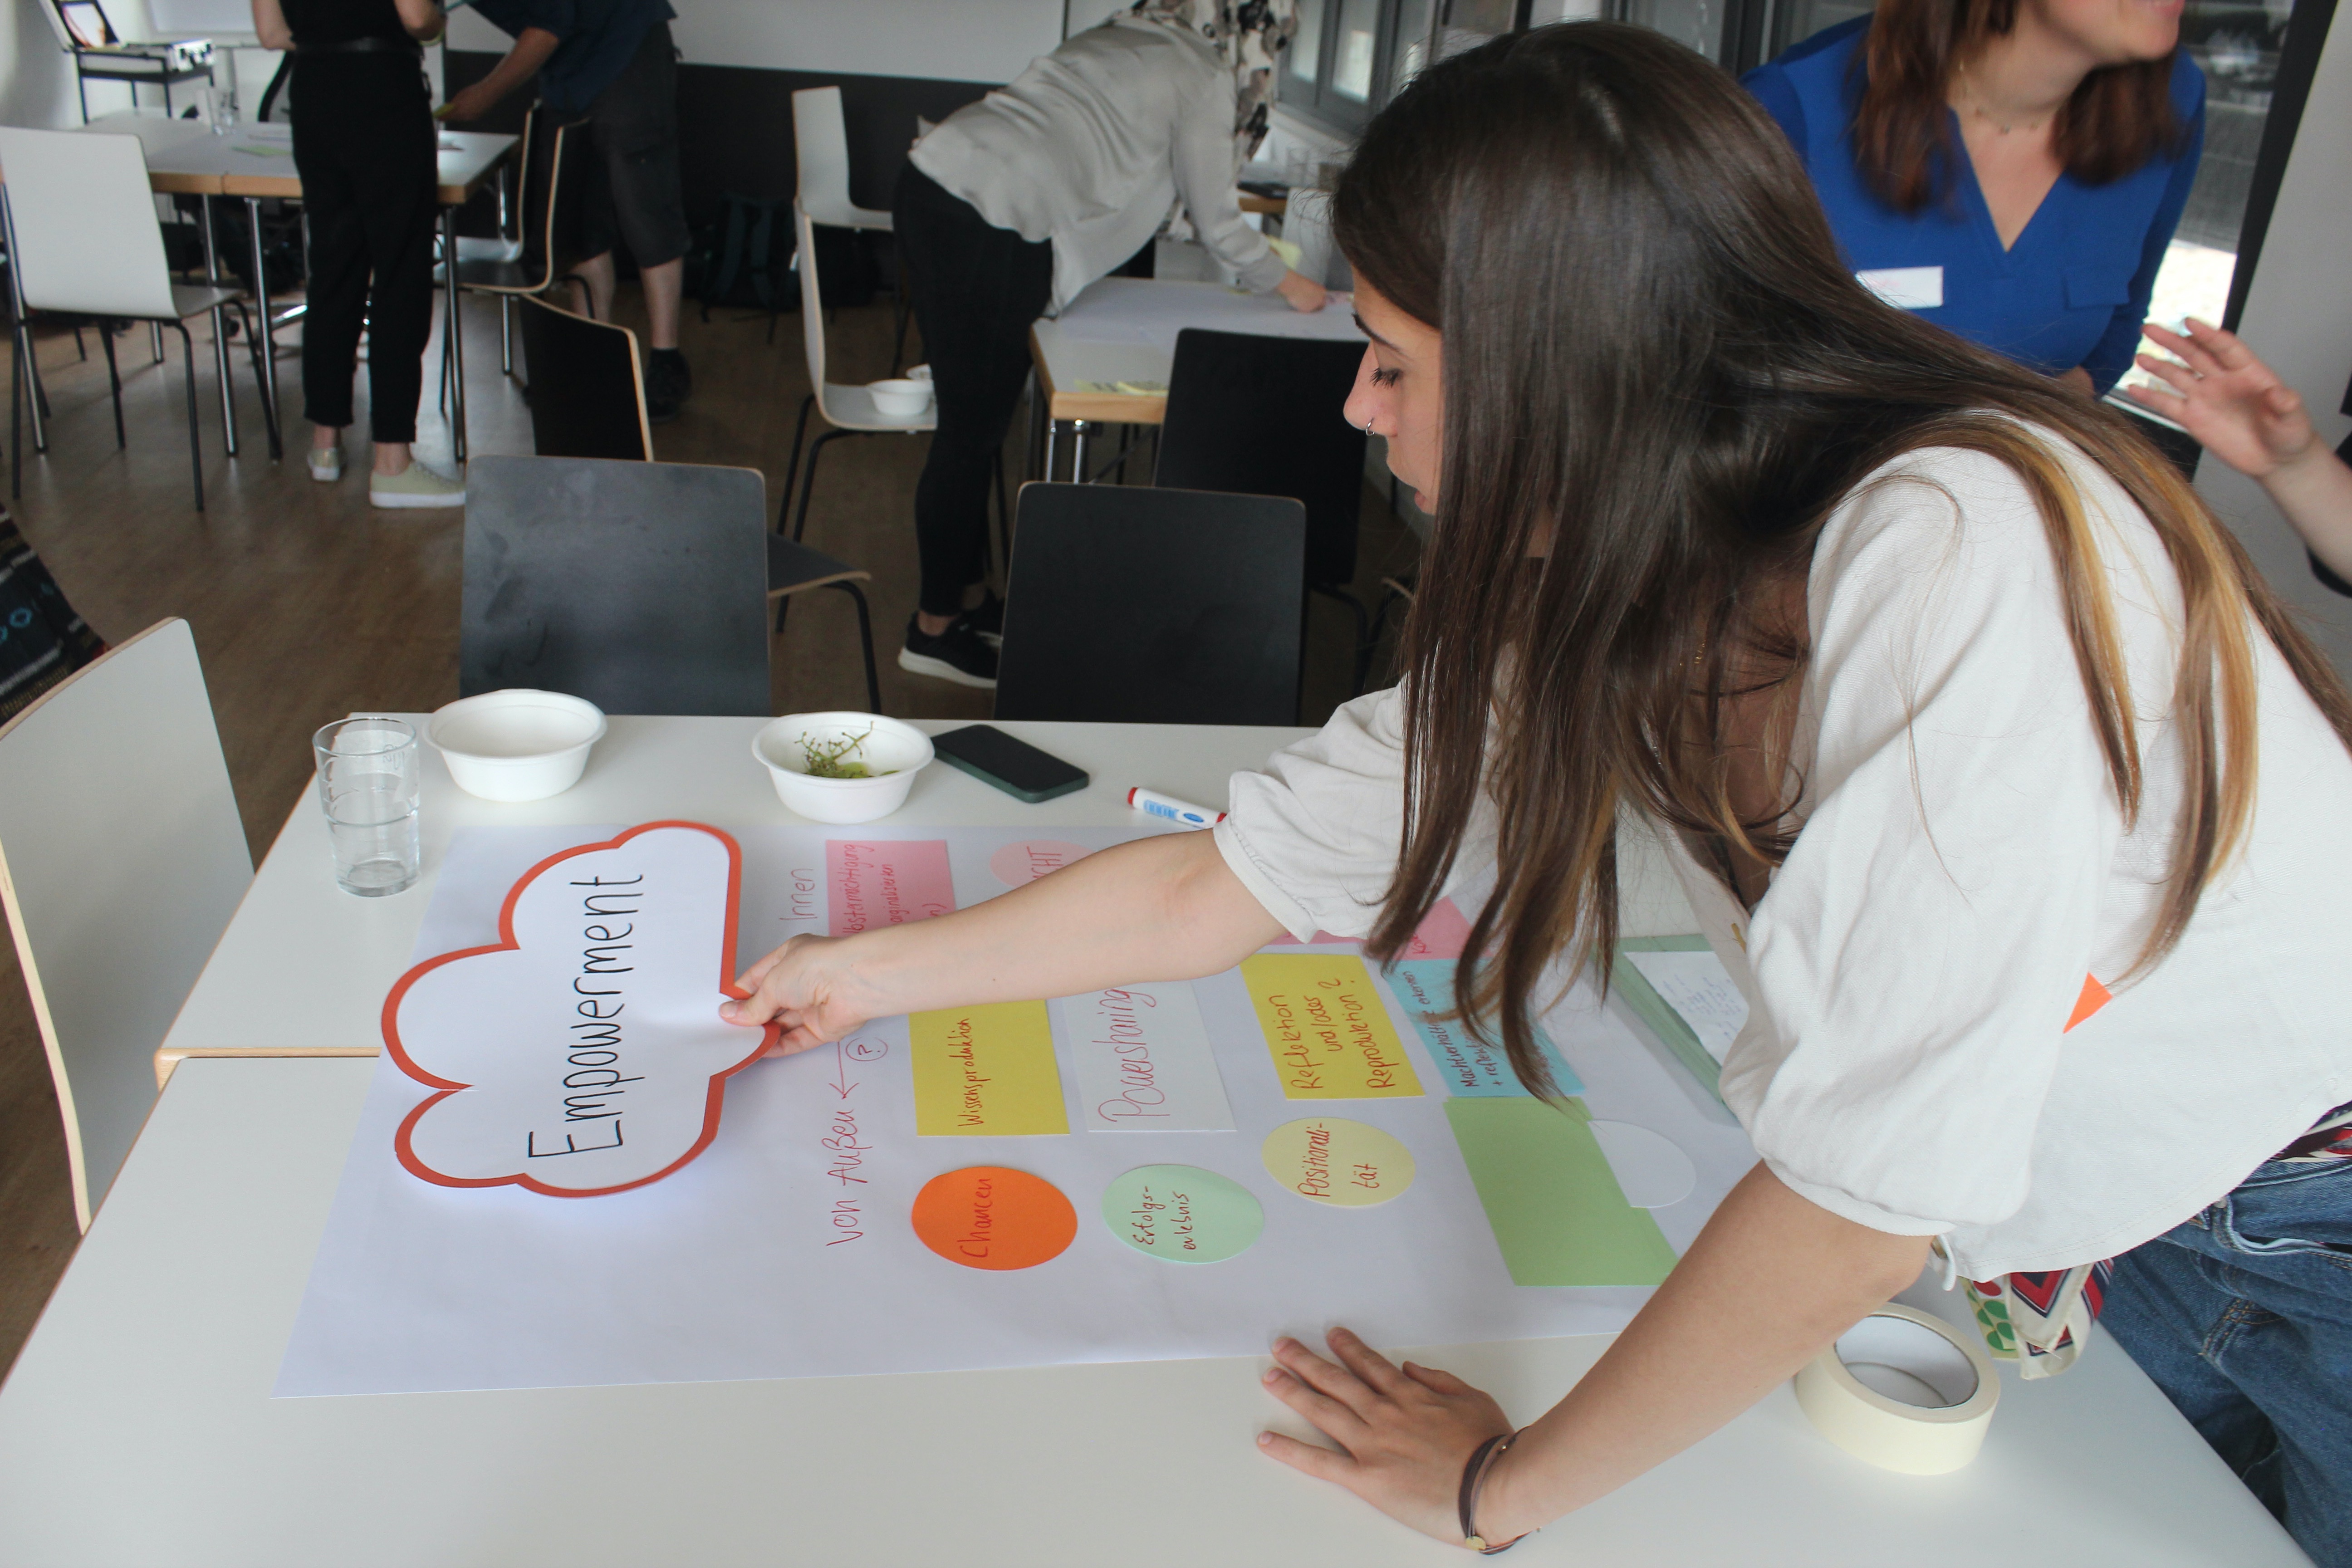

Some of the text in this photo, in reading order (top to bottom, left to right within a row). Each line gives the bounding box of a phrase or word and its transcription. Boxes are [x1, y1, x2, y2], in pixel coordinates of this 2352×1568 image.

[779, 868, 818, 921] Innen
[528, 874, 645, 1159] Empowerment
[1092, 988, 1171, 1122] Powersharing
[1268, 995, 1324, 1089] Reflektion
[948, 1018, 992, 1127] Wissensproduktion
[821, 1108, 873, 1186] Außen
[956, 1178, 993, 1258] Chancen
[1130, 1186, 1166, 1245] Erfolgs-
[1169, 1191, 1197, 1250] erlebnis
